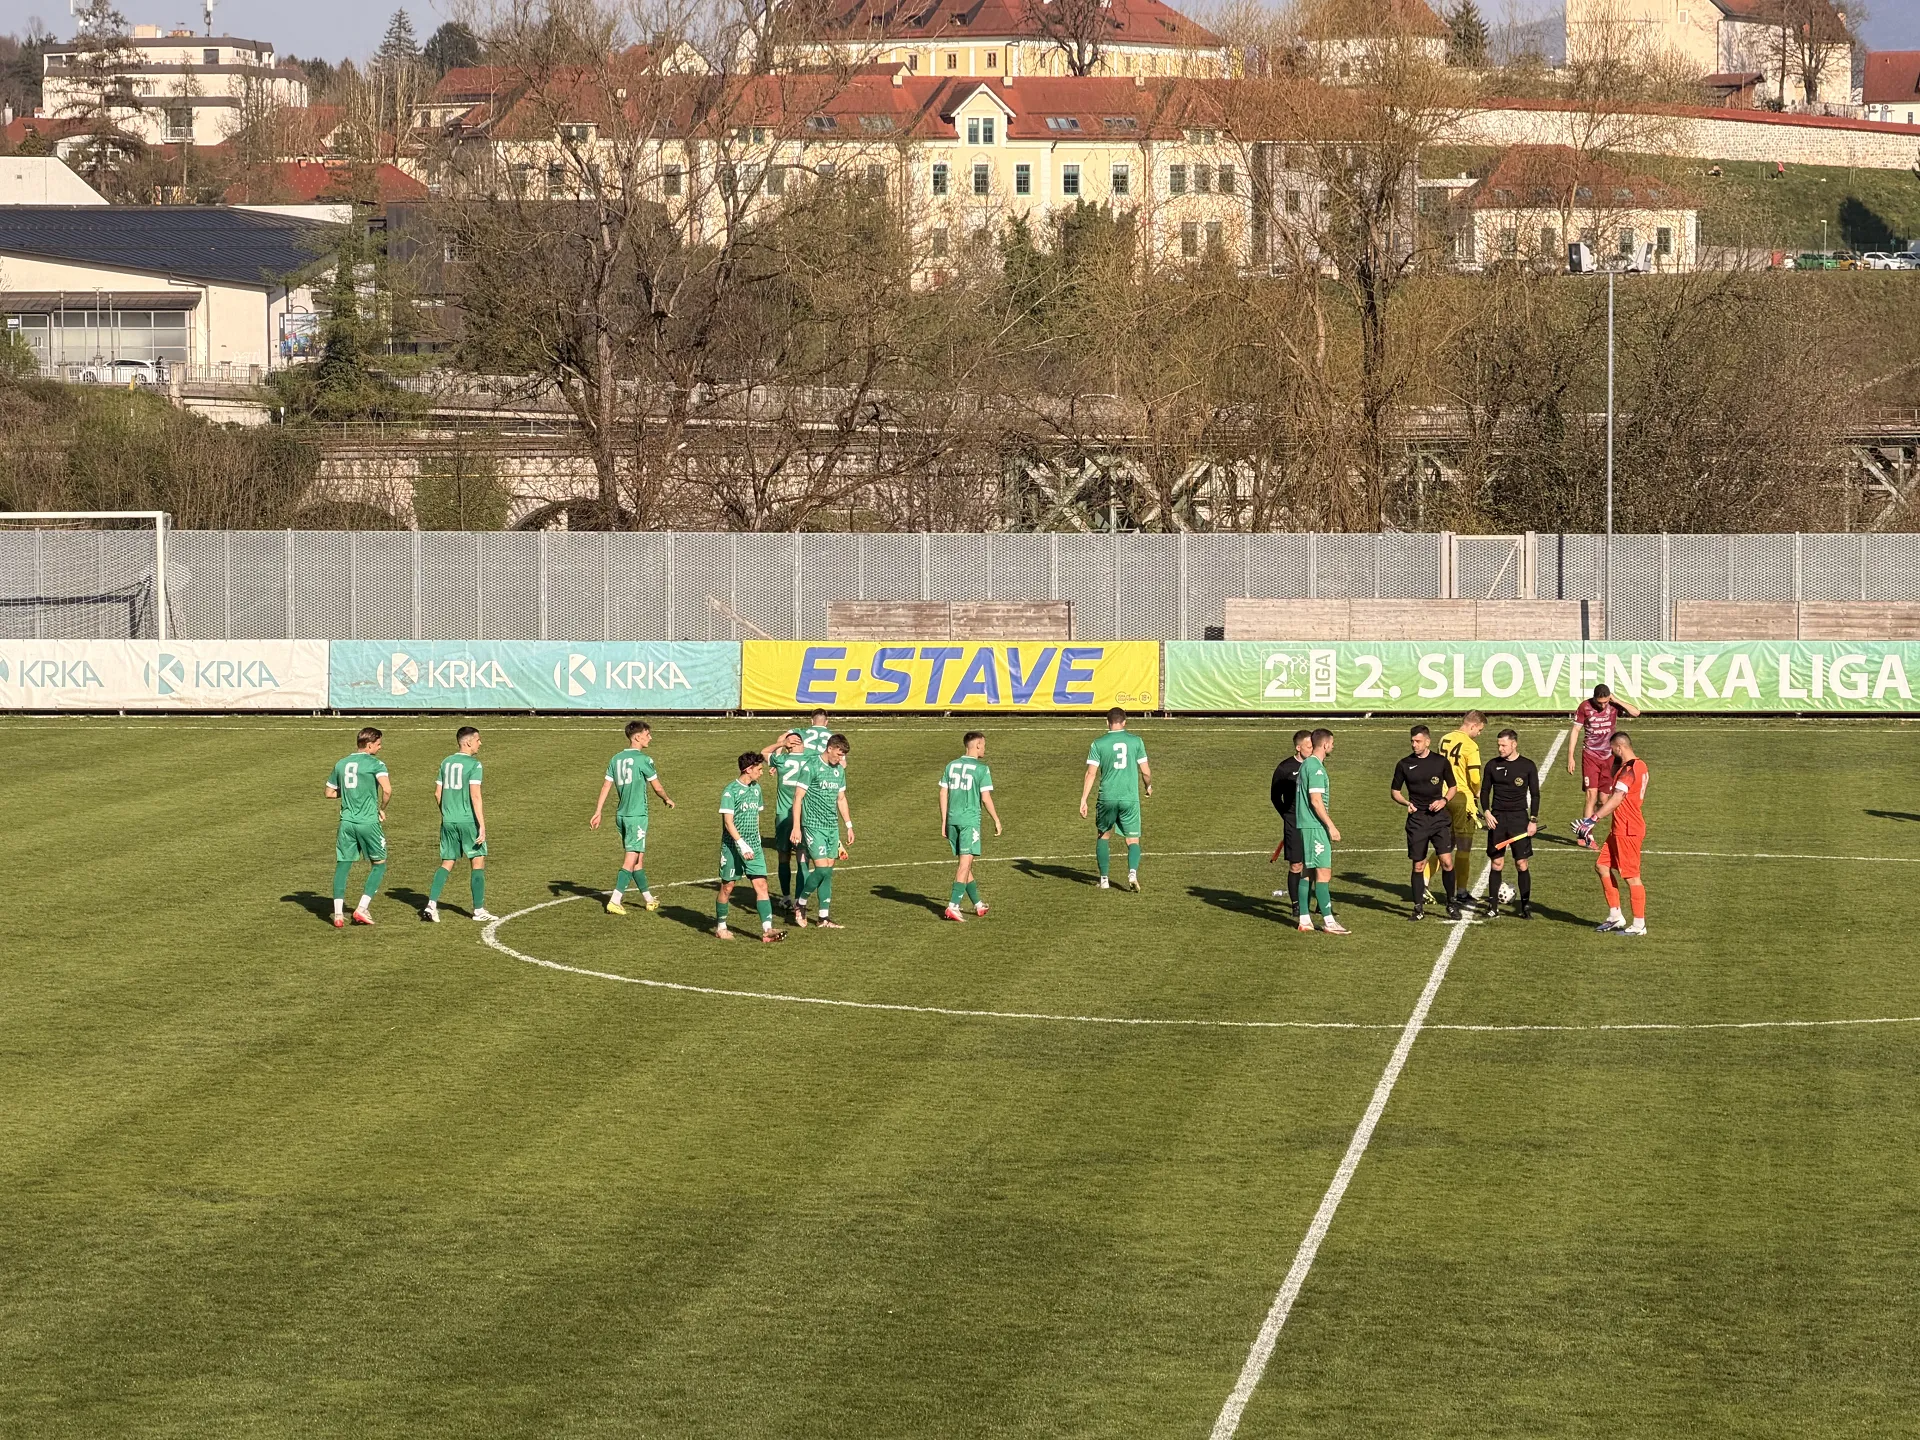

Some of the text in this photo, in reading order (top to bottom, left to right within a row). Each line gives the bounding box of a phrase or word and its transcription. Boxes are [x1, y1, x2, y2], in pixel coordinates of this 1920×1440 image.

[19, 660, 105, 688] KRKA
[195, 660, 281, 688] KRKA
[428, 660, 514, 688] KRKA
[606, 661, 692, 690] KRKA
[1315, 654, 1331, 698] LIGA
[1352, 653, 1913, 699] 2. SLOVENSKA LIGA
[803, 729, 833, 753] 23
[1112, 742, 1128, 770] 3
[344, 762, 359, 789] 8
[444, 762, 464, 790] 10
[616, 757, 634, 786] 16
[782, 759, 807, 787] 2
[948, 763, 977, 791] 55
